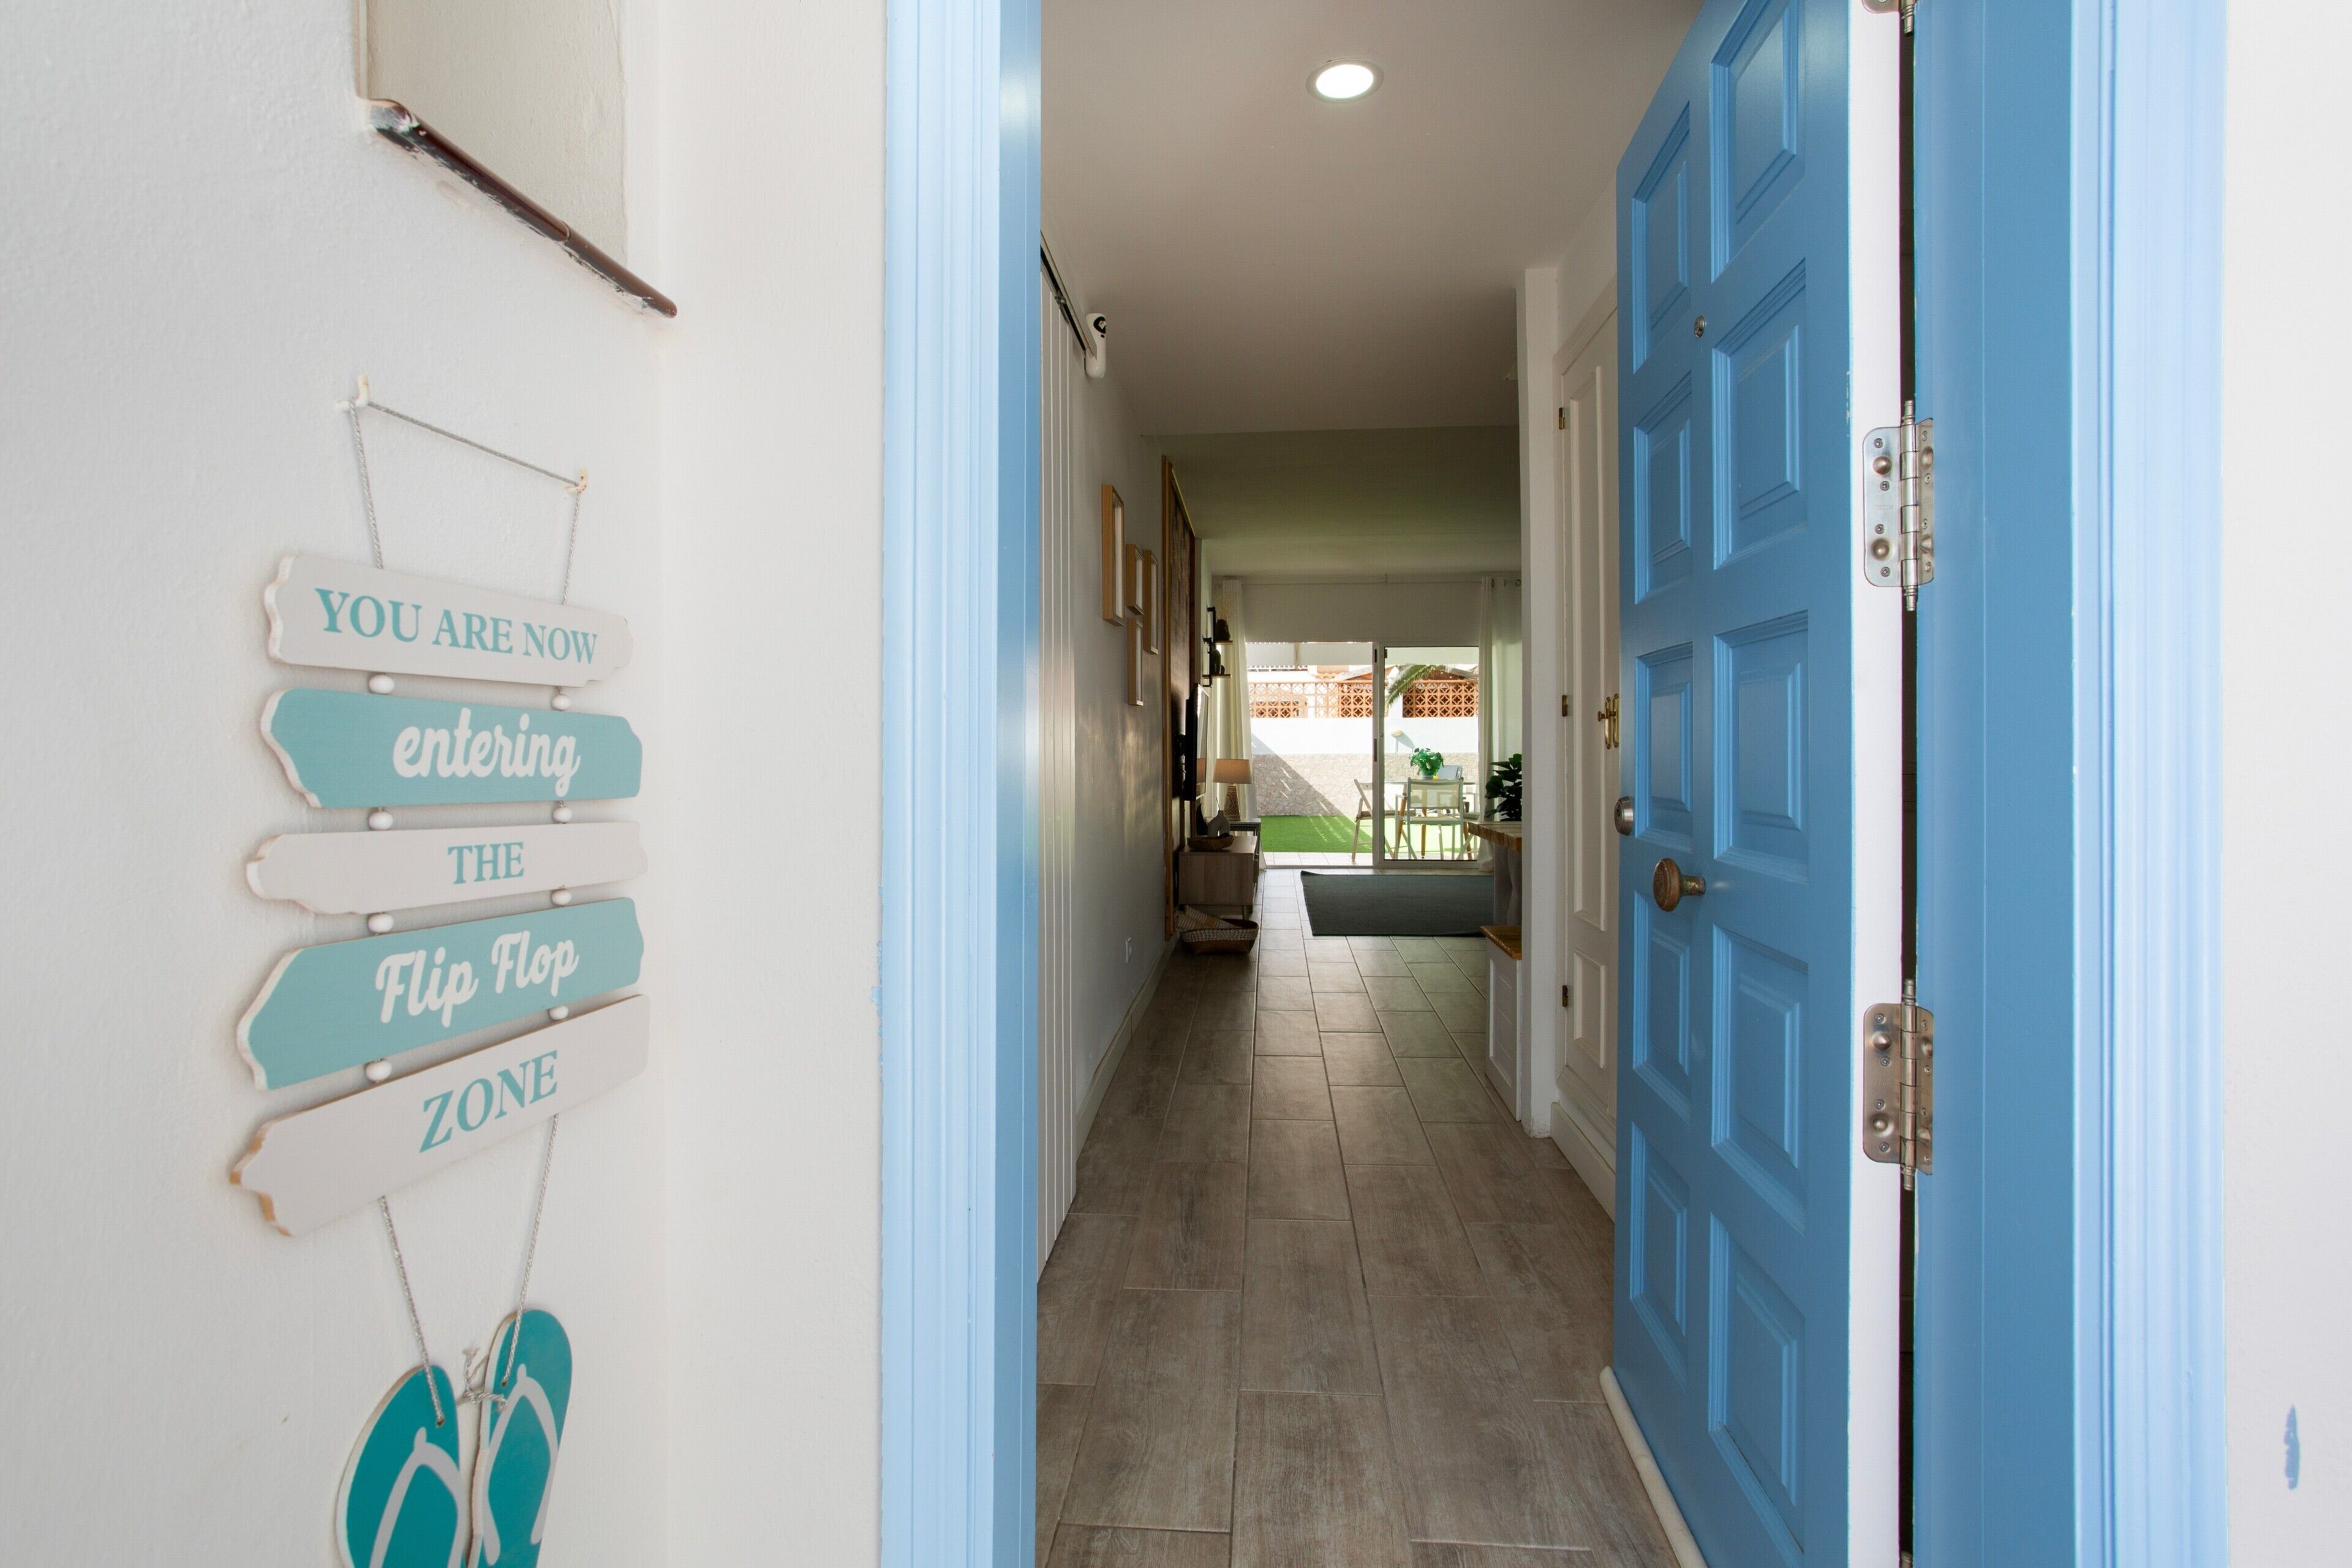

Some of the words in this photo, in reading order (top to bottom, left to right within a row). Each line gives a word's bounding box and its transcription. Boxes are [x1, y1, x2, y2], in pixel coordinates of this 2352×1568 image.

[314, 588, 423, 643] YOU
[432, 609, 513, 654] ARE
[522, 622, 597, 665] NOW
[393, 707, 581, 797] entering
[448, 842, 525, 884] THE
[375, 947, 478, 1028] Flip
[491, 930, 579, 997] Flop
[419, 1050, 558, 1153] ZONE
